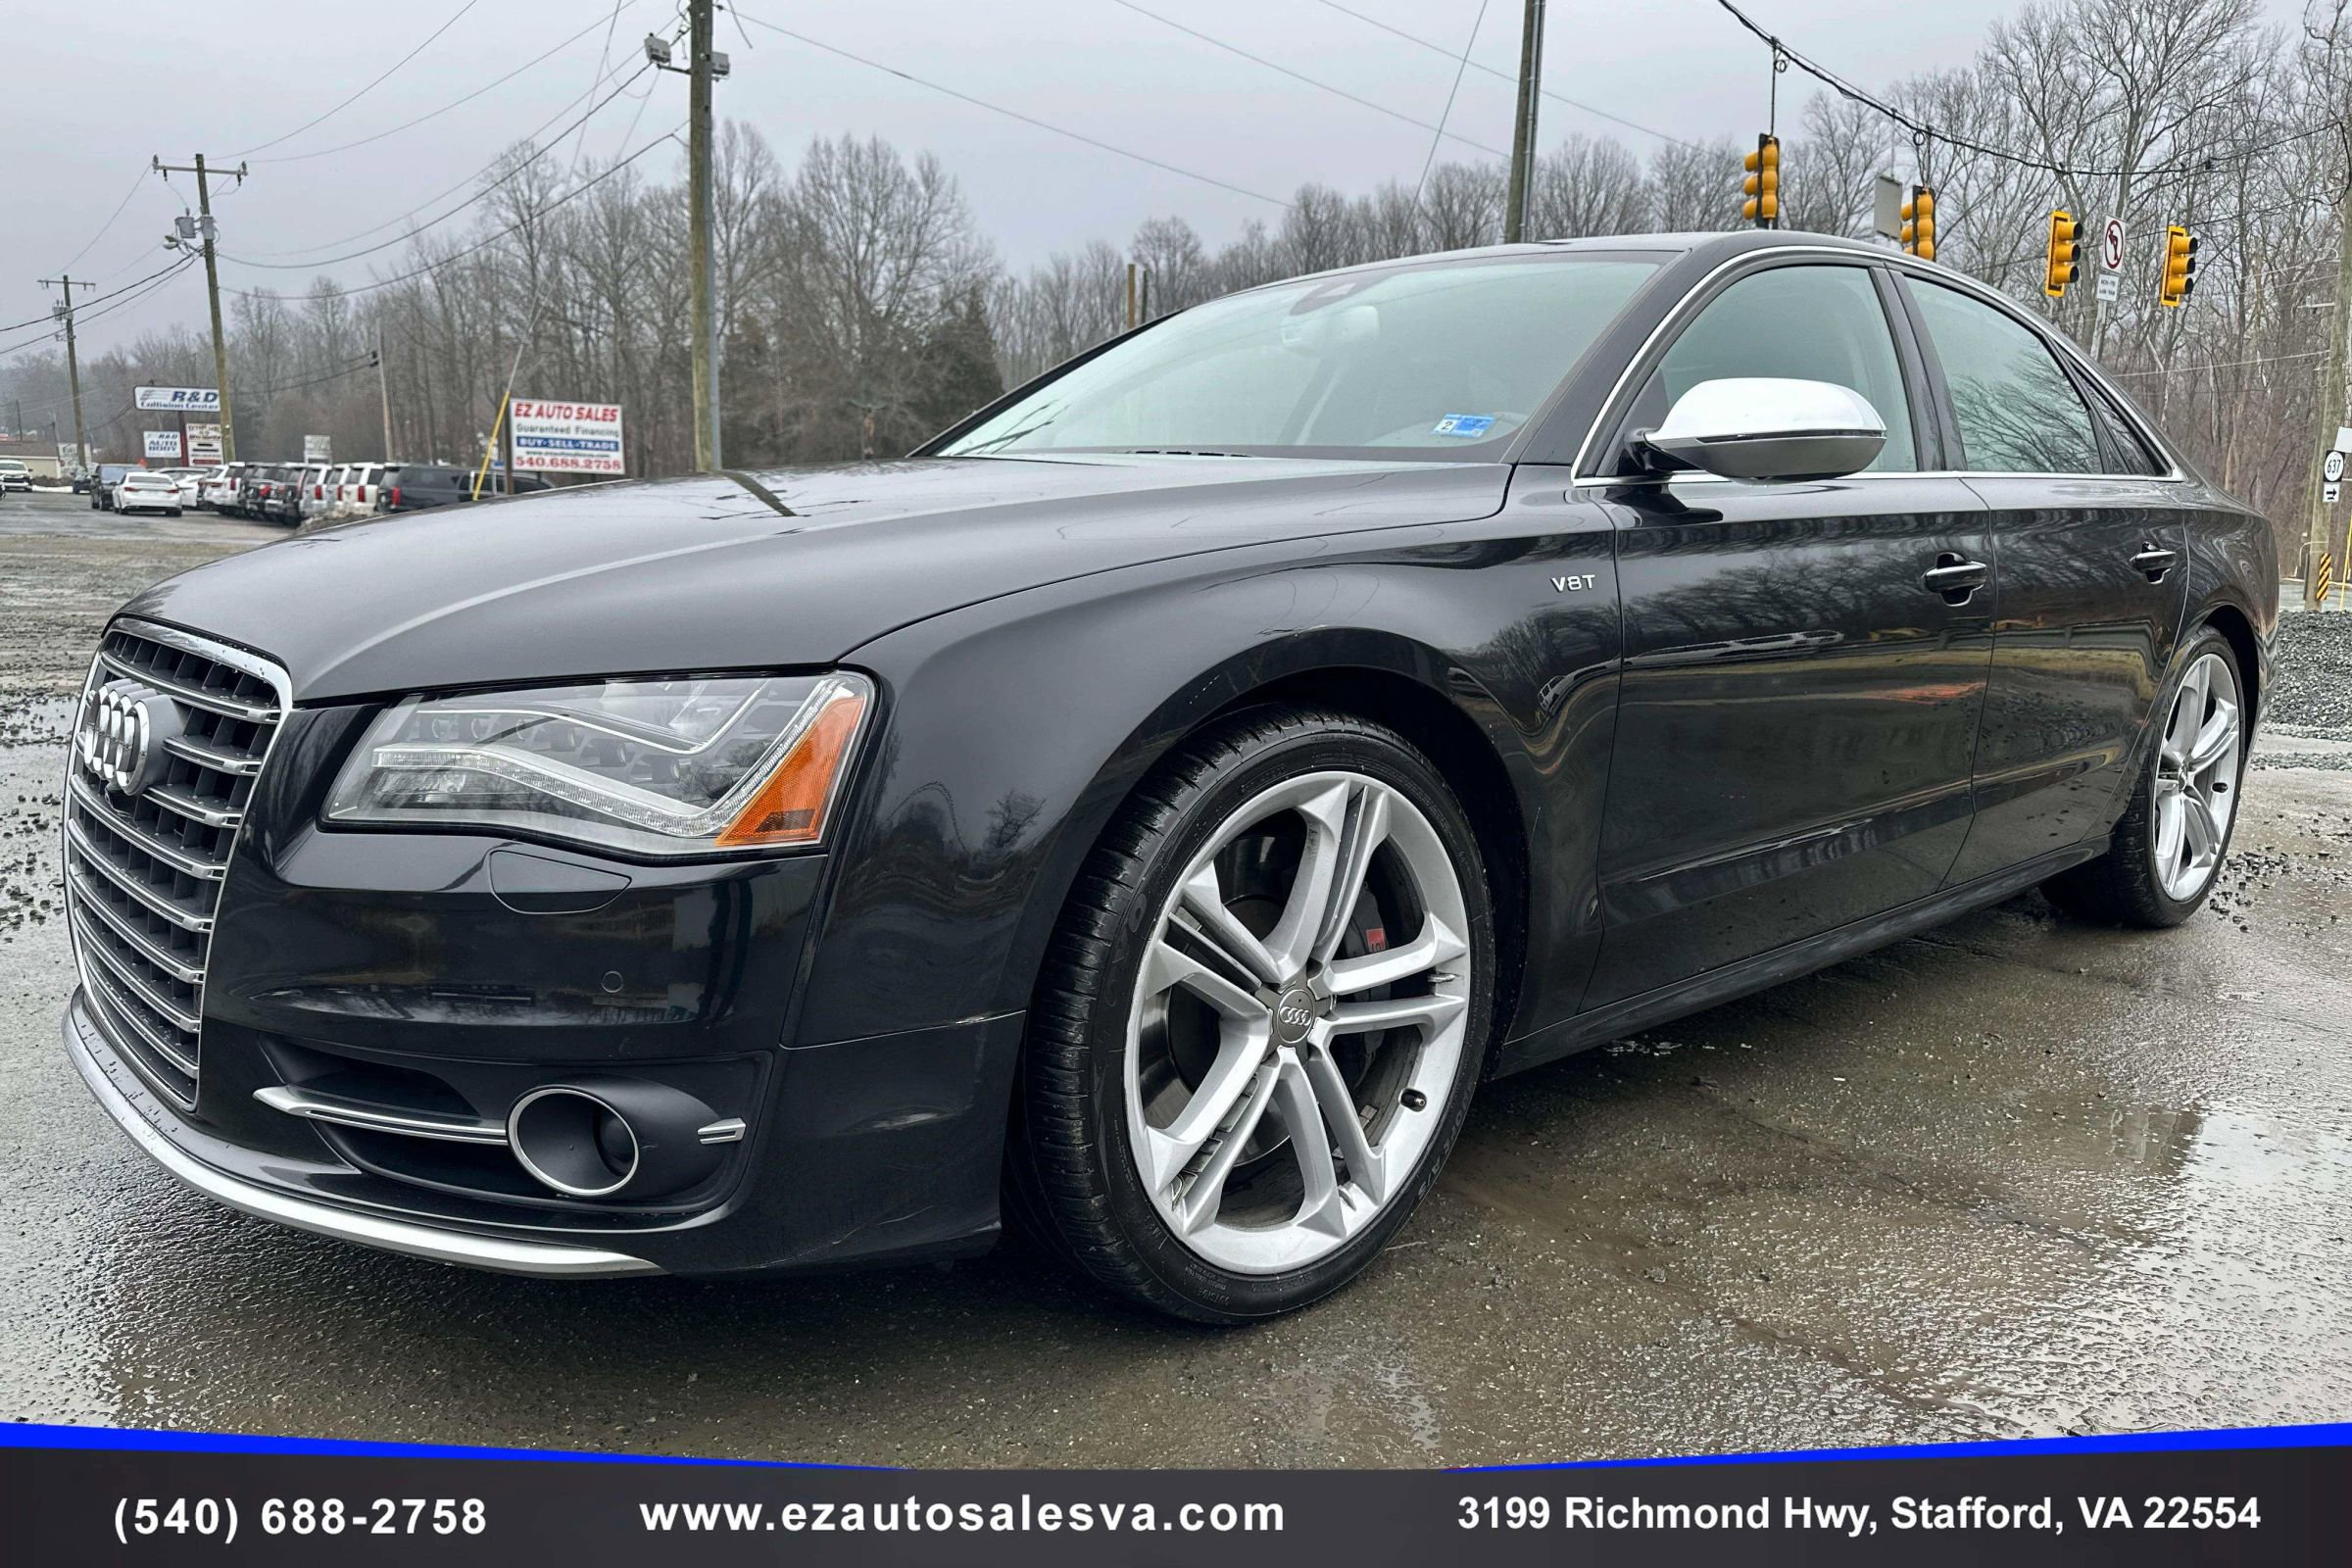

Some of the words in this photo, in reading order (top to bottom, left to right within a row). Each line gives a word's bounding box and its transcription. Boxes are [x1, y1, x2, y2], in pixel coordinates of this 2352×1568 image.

[172, 390, 219, 403] R&D
[514, 403, 532, 416] EZ
[535, 405, 572, 419] AUTO
[575, 407, 617, 421] SALES
[516, 423, 571, 433] Guaranteed
[574, 425, 619, 437] Financing
[1442, 420, 1453, 430] 2
[2327, 459, 2341, 473] 637
[1550, 573, 1595, 593] V8T
